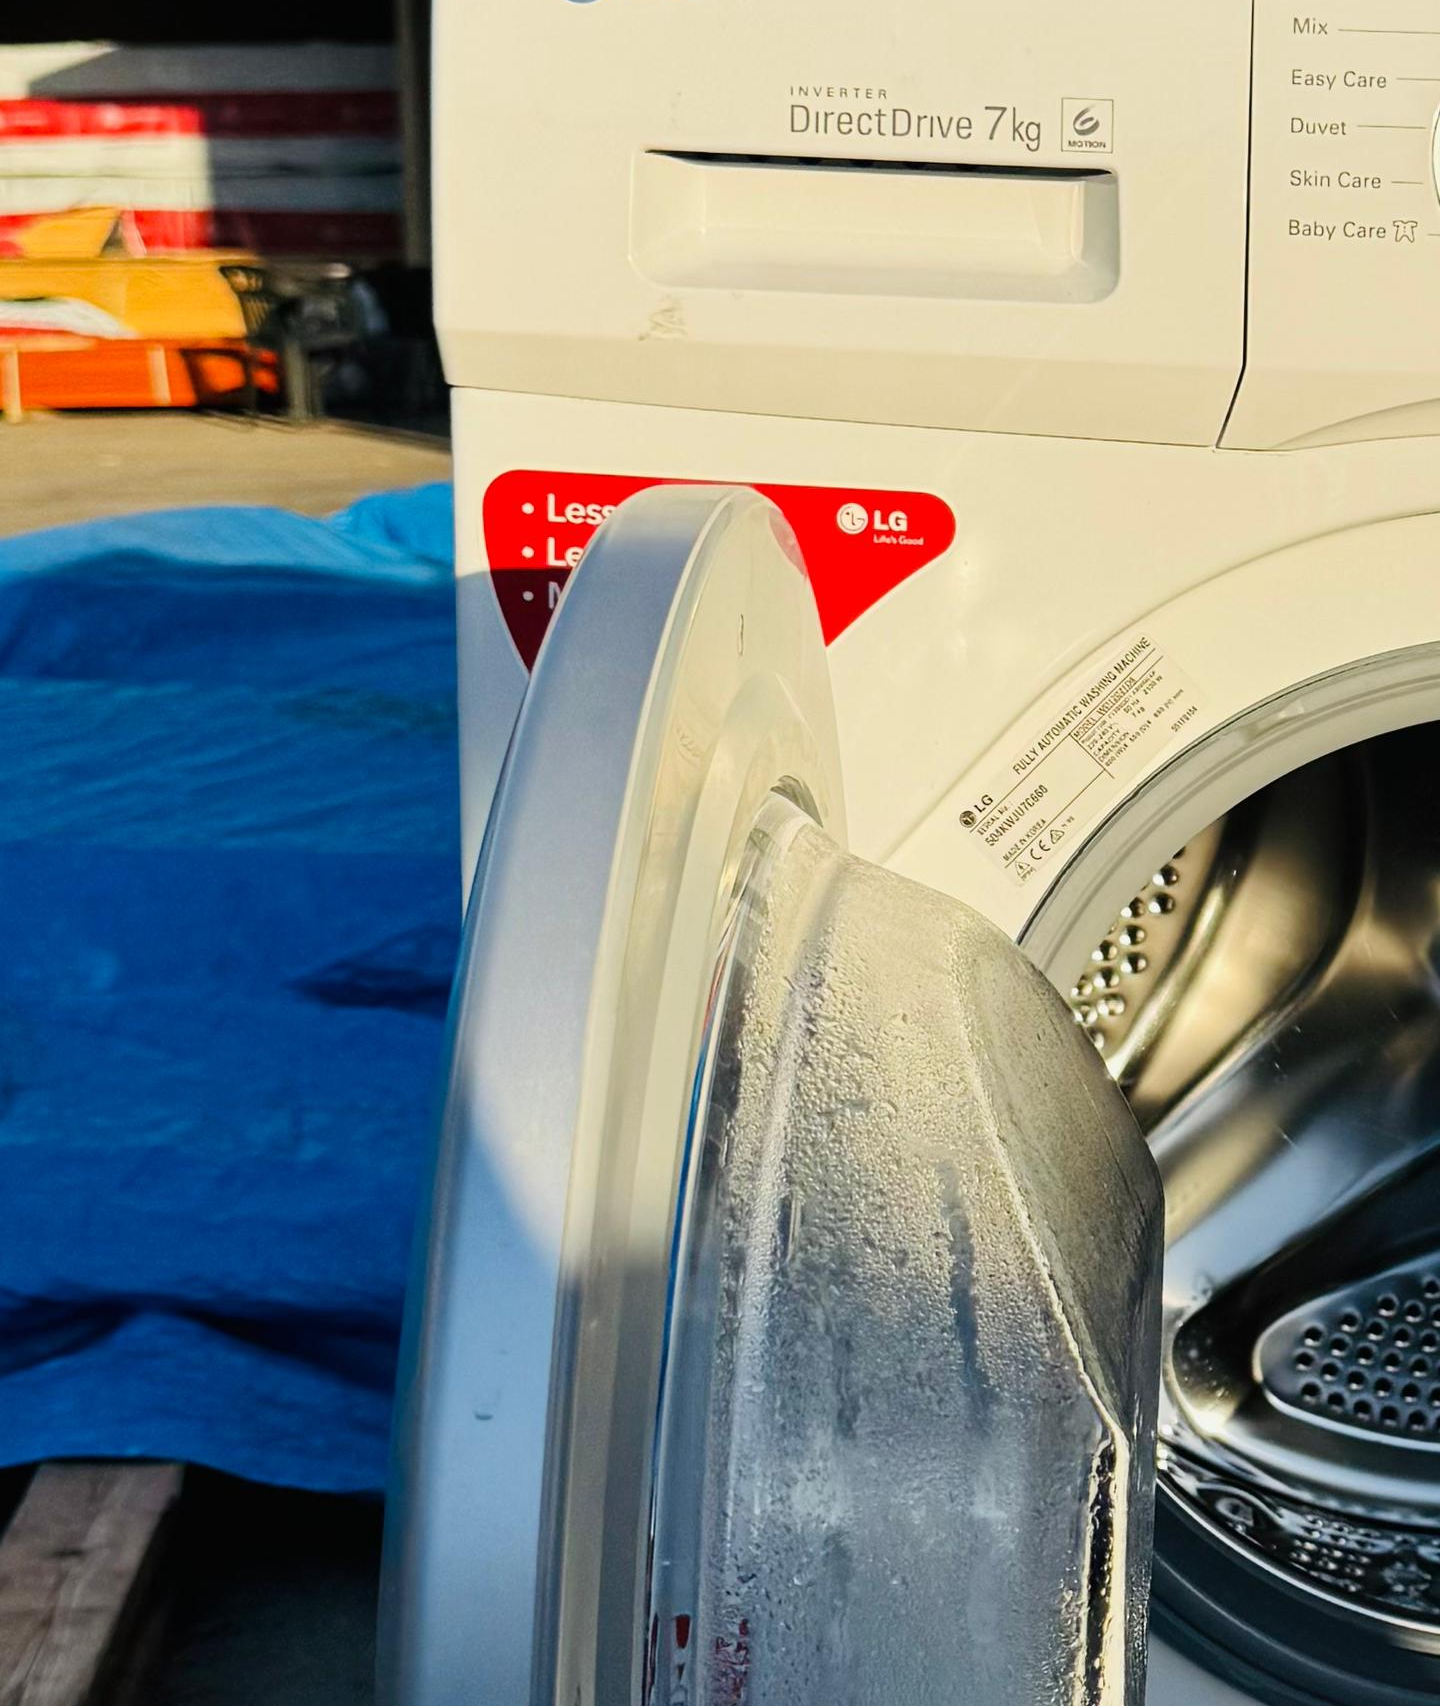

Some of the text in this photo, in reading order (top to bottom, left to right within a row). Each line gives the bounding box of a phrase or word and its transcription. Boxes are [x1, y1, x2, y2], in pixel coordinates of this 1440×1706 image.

[1293, 17, 1328, 35] Mix
[1291, 69, 1387, 90] Easy Care
[790, 86, 887, 99] INVERTER
[1290, 117, 1347, 136] Duvet
[1067, 140, 1107, 149] MOTION
[1289, 169, 1381, 189] Skin Care
[1288, 219, 1387, 240] Baby Care
[873, 509, 908, 532] LG
[898, 535, 924, 545] Good
[547, 536, 584, 568] Le
[1011, 746, 1040, 775] FULLY
[1035, 703, 1083, 752] AUTOMATIC
[1078, 669, 1117, 709] WASHING
[1113, 635, 1151, 674] MACHINE
[973, 793, 994, 814] LG
